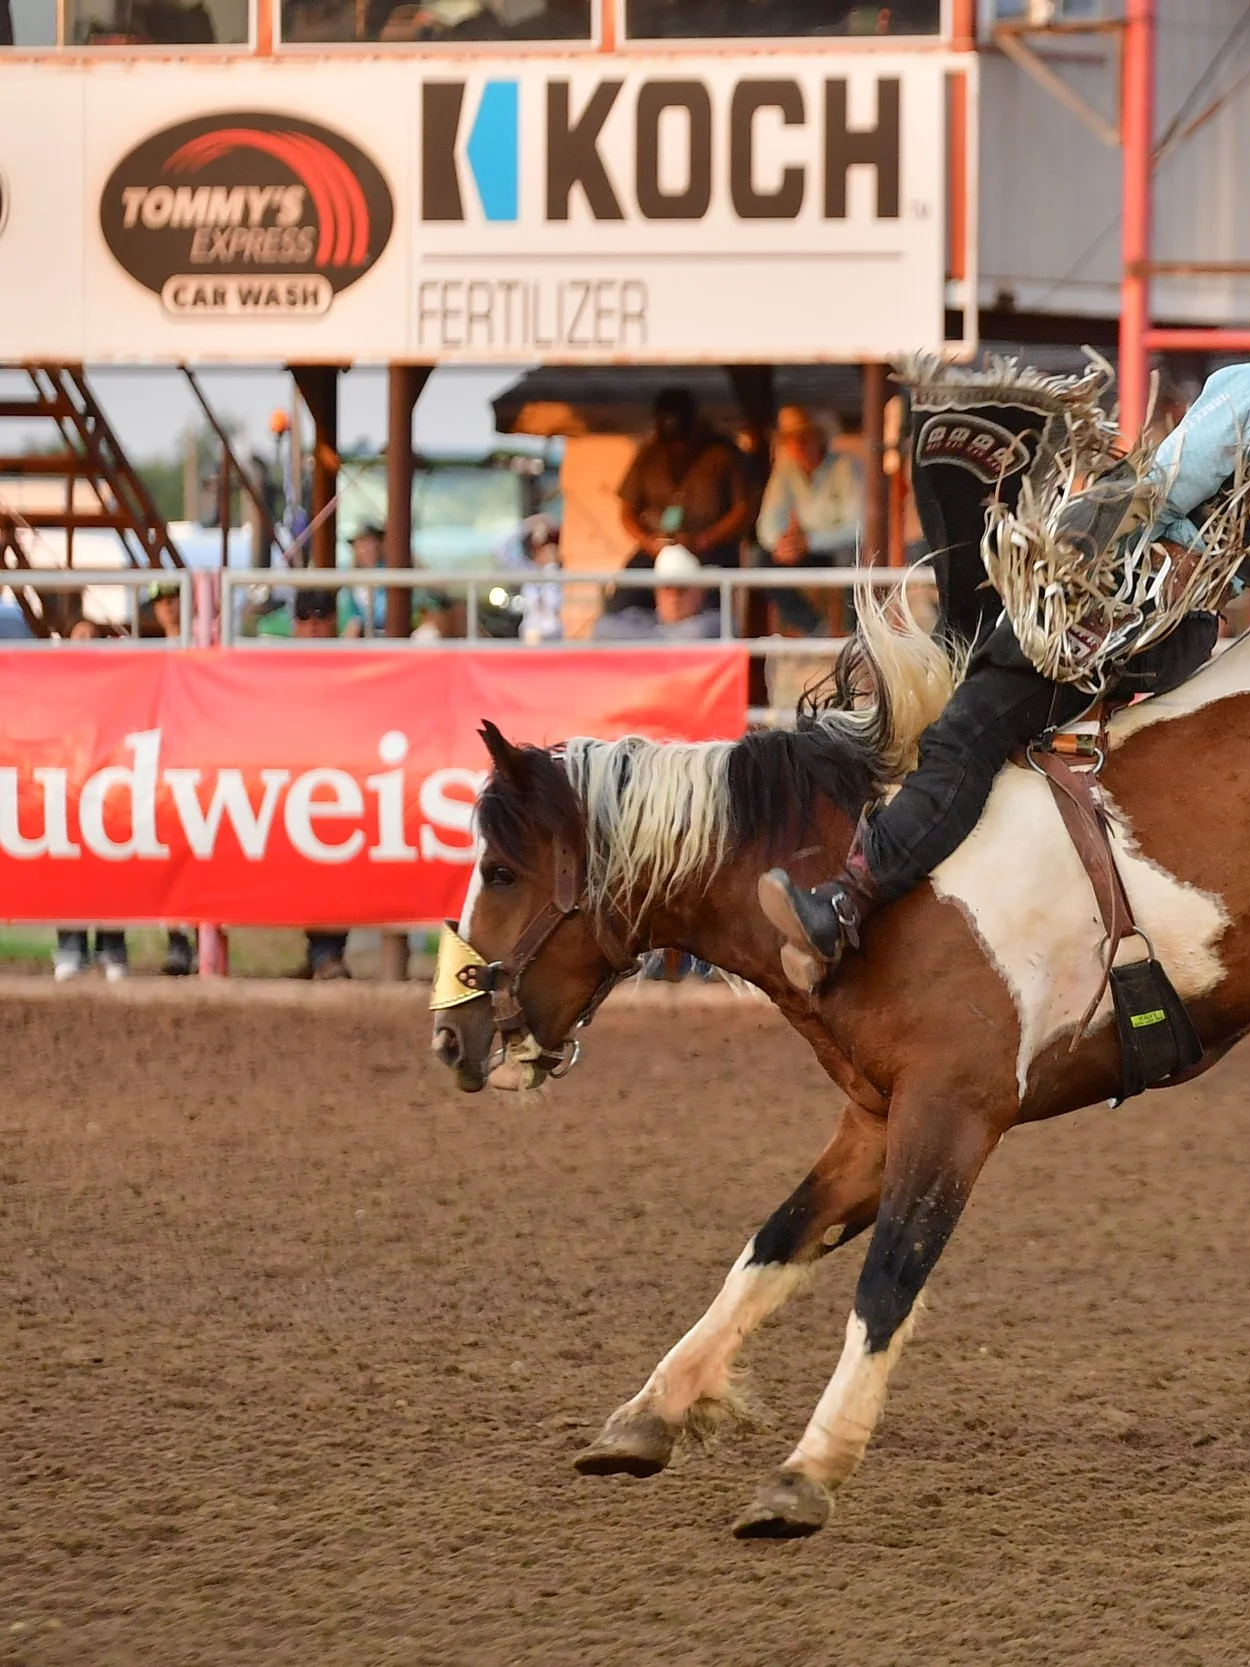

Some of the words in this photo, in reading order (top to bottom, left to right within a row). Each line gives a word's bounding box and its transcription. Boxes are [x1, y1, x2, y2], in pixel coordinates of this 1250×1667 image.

[545, 79, 900, 220] KOCH
[121, 185, 306, 229] TOMMY'S
[190, 226, 317, 264] EXPRESS
[173, 283, 226, 306] CAR
[239, 282, 320, 306] WASH
[418, 279, 648, 348] FERTILIZER
